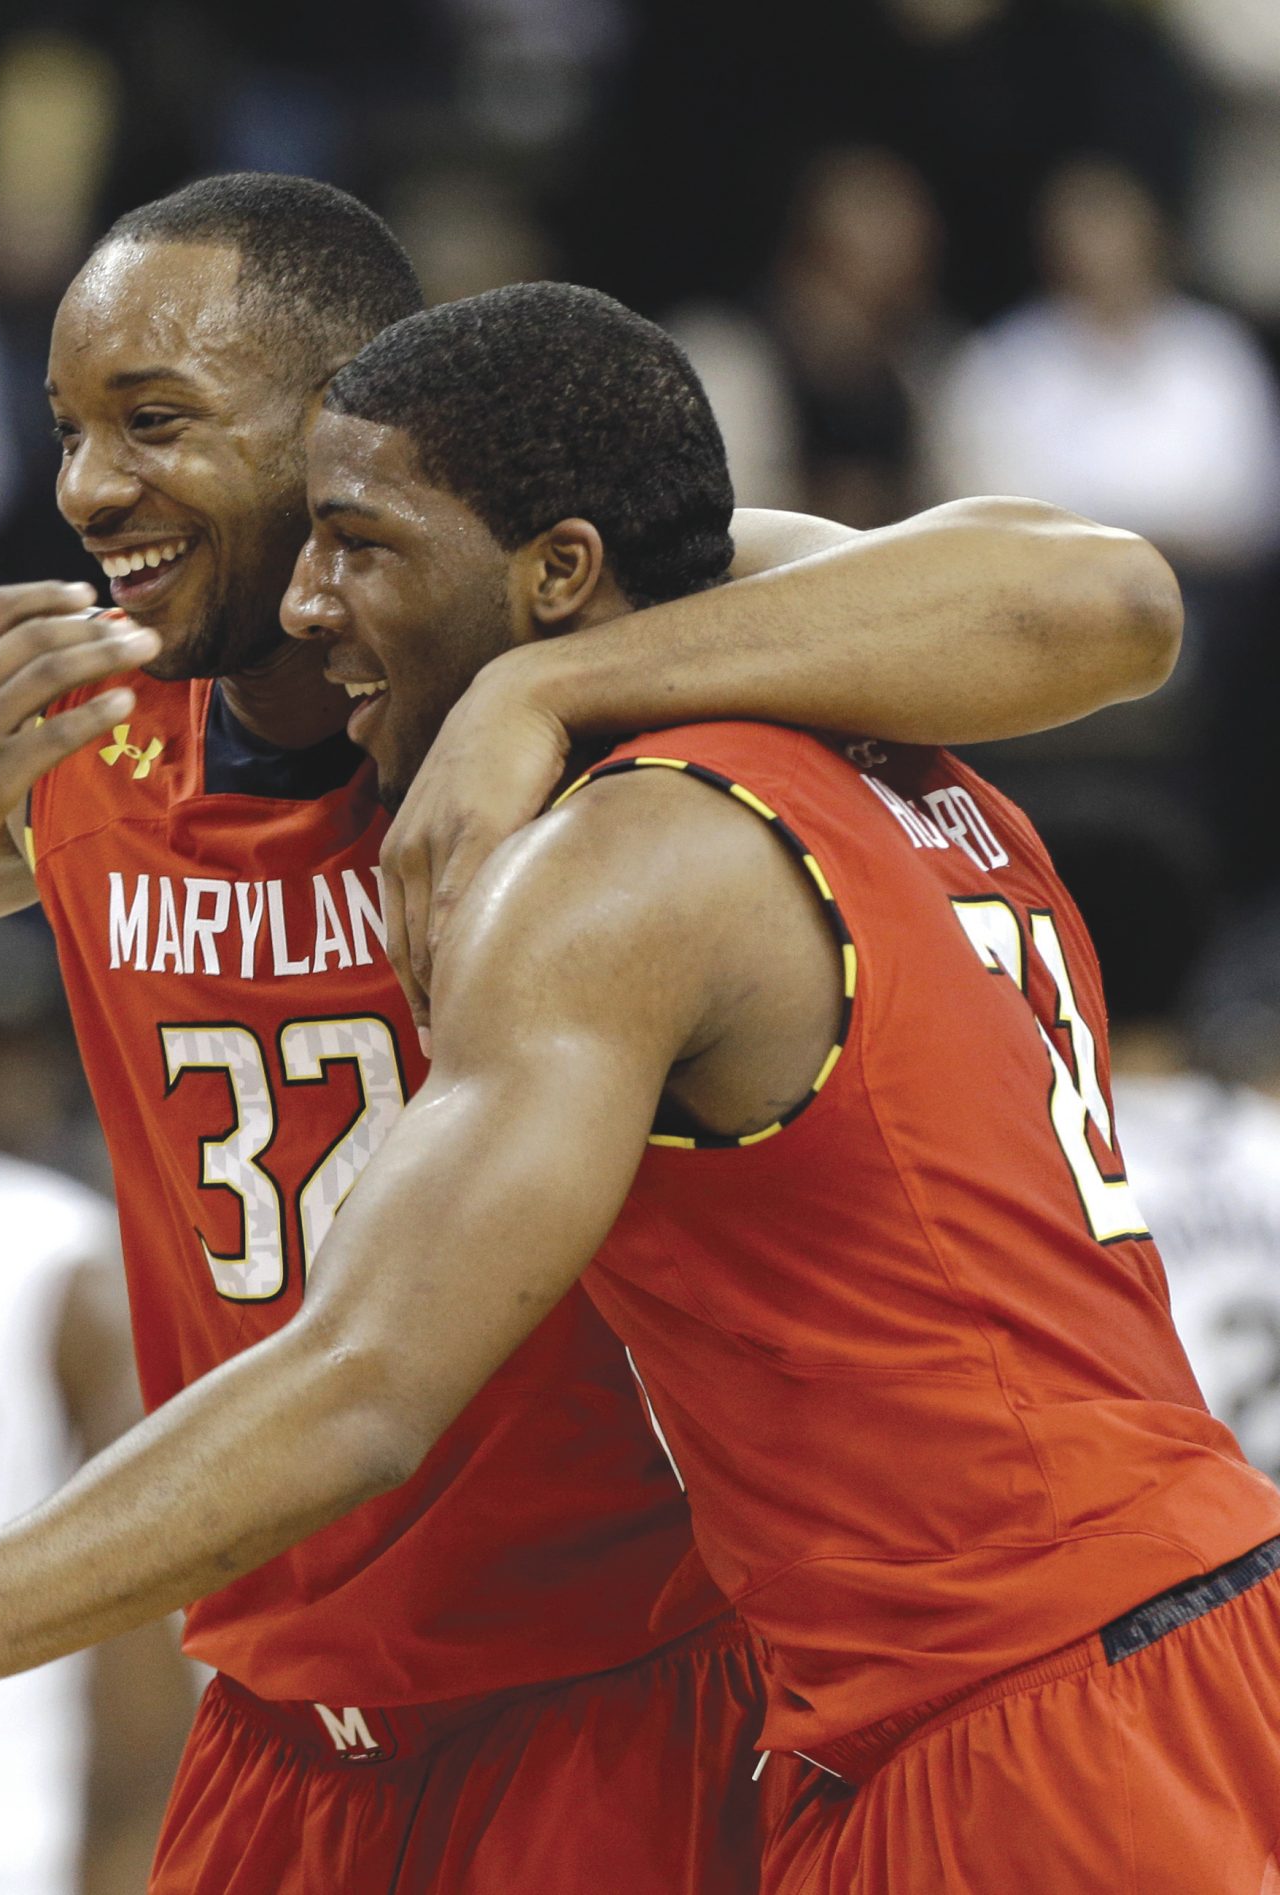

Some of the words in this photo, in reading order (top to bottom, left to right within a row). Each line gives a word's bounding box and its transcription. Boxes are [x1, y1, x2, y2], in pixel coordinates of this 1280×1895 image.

[108, 866, 388, 979] MARYLAN
[158, 1013, 406, 1303] 32
[314, 1703, 379, 1750] M
